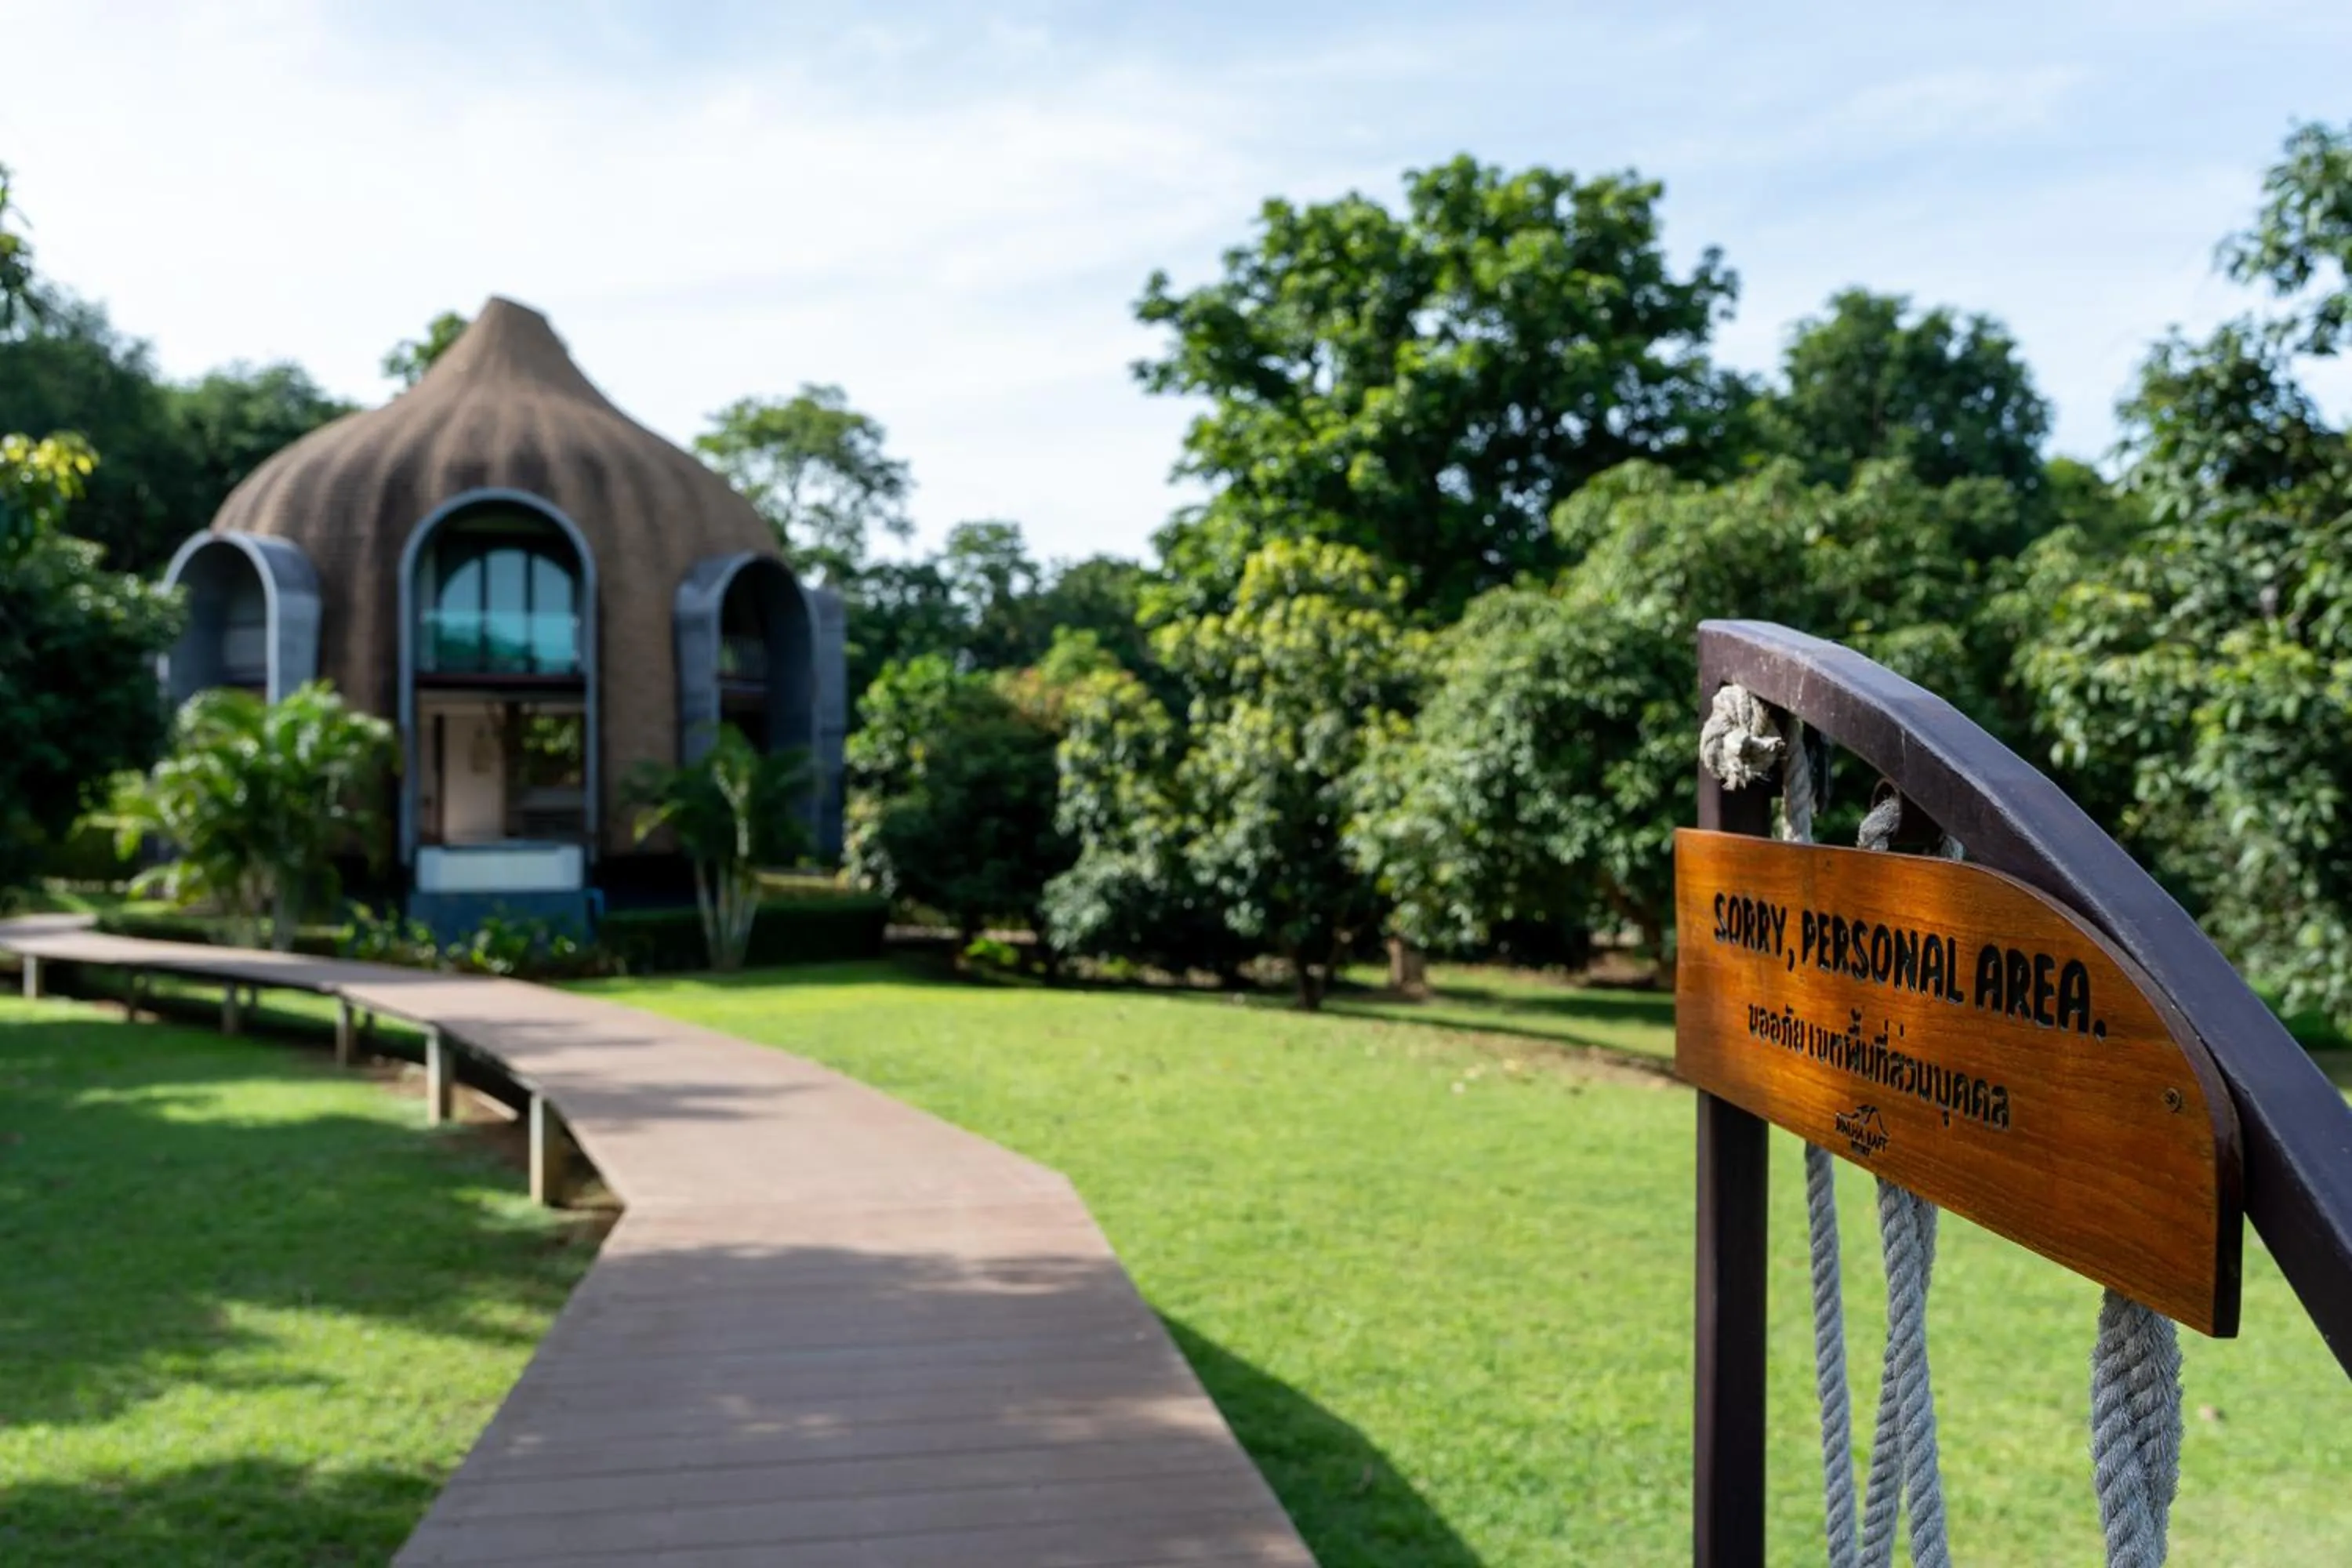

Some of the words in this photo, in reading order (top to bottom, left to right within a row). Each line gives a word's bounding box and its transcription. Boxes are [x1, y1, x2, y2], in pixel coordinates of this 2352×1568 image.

[1713, 892, 1795, 973] SORRY,
[1802, 909, 1965, 1004] PERSONAL
[1974, 944, 2107, 1040] AREA.
[1748, 1003, 1805, 1053] ขออภัย
